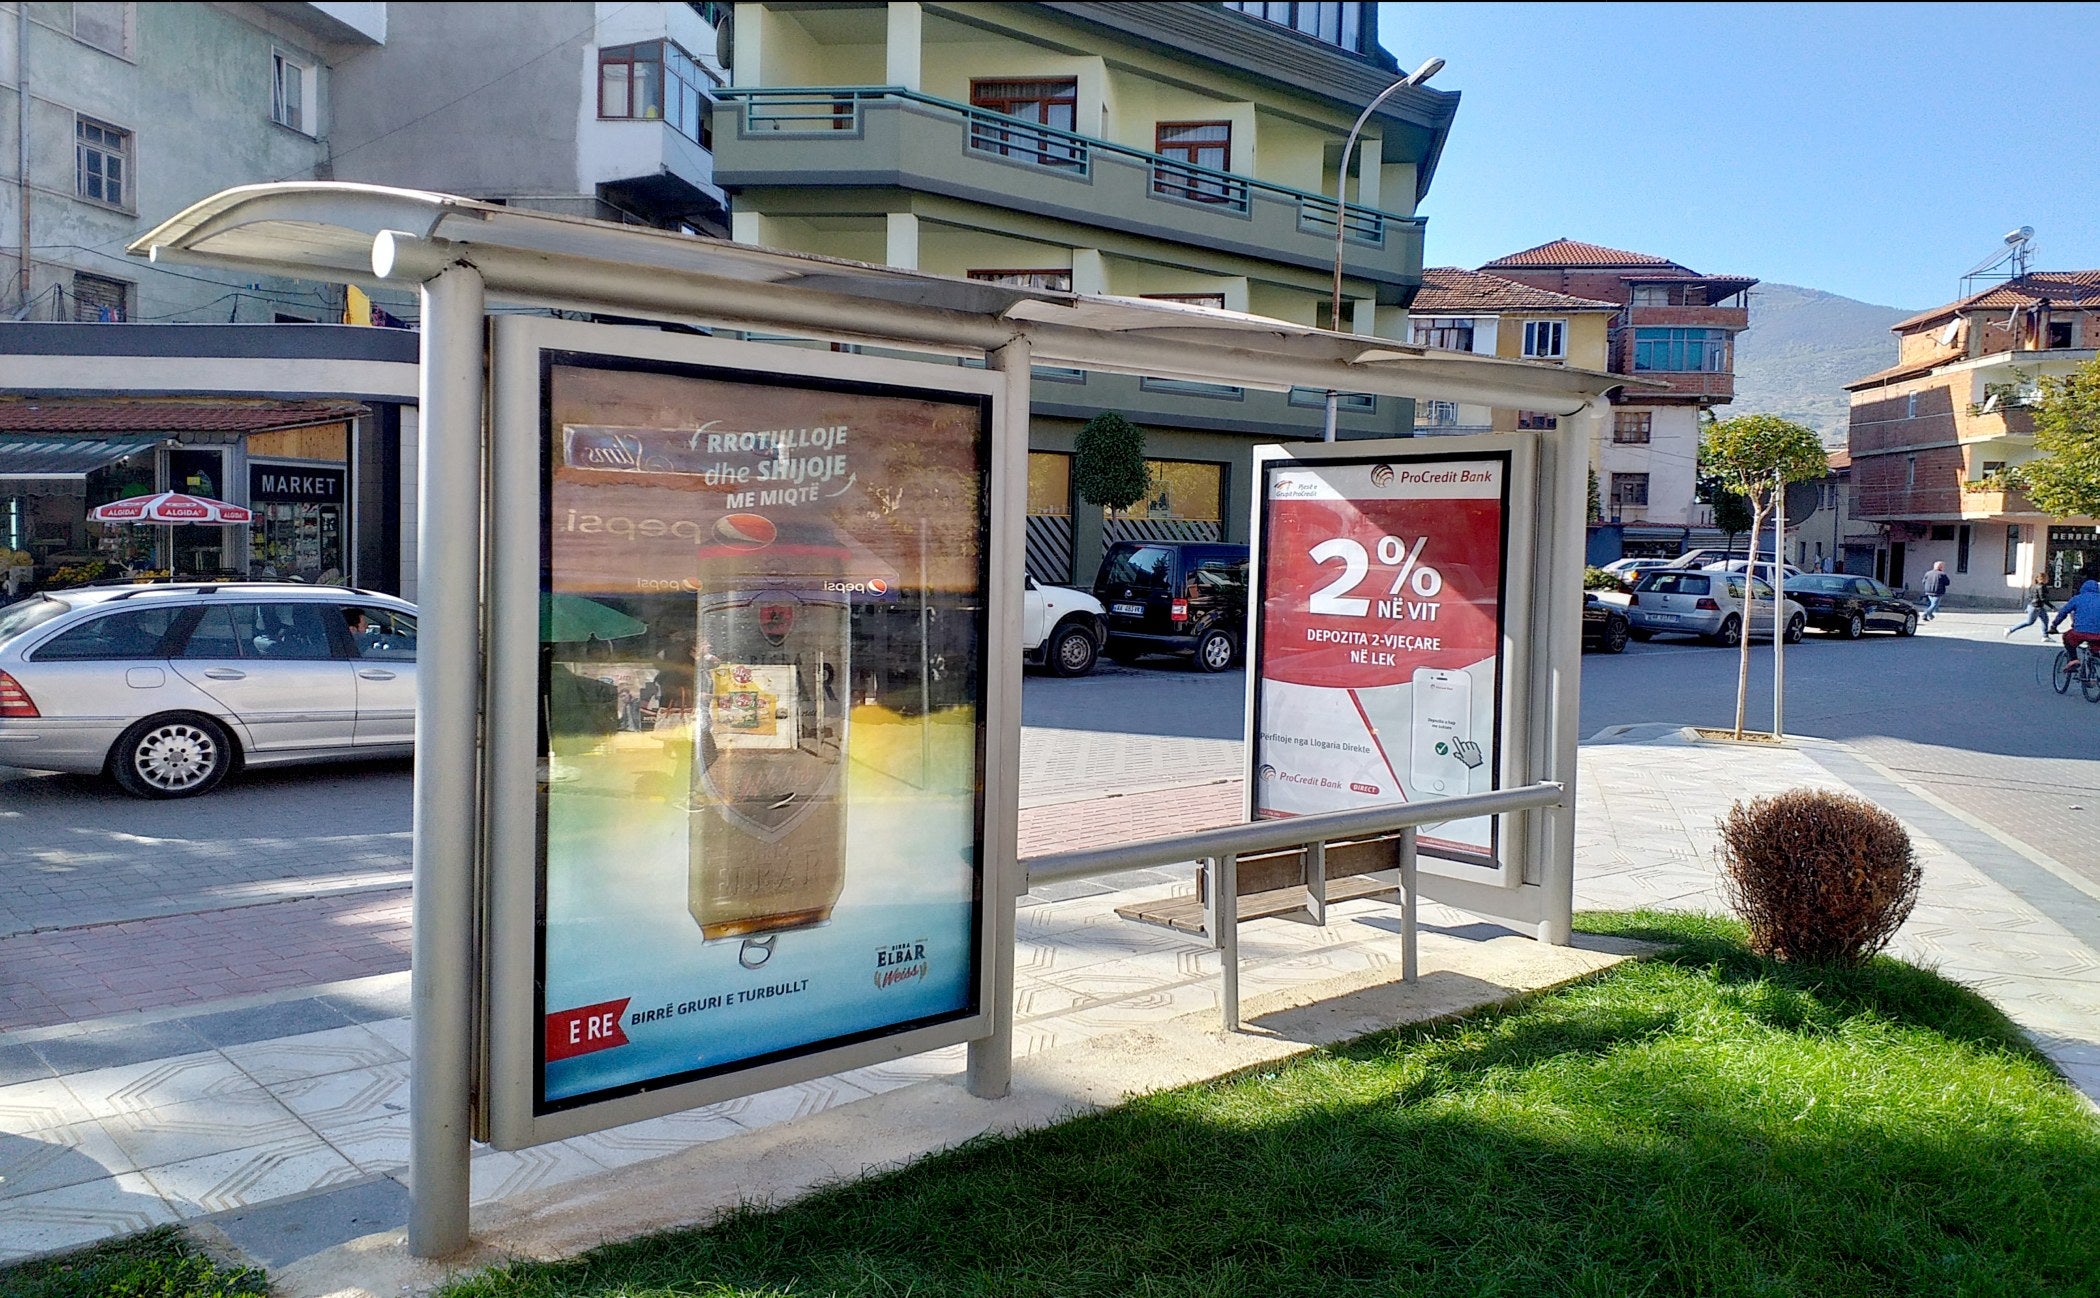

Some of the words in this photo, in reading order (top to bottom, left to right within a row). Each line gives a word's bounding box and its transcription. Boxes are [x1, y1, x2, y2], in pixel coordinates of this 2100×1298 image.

[707, 426, 848, 453] RROTULLOJE
[704, 462, 750, 486] dhe
[757, 455, 847, 485] SHIJOJE
[1401, 470, 1457, 483] ProCredit
[1460, 470, 1492, 482] Bank
[262, 475, 336, 495] MARKET
[726, 492, 755, 509] ME
[760, 482, 819, 507] MIQTË
[108, 509, 135, 517] ALGIDA
[165, 509, 200, 517] ALGIDA
[1309, 534, 1442, 617] 2%
[2053, 550, 2064, 588] MARKO
[1378, 597, 1404, 619] NË
[1407, 601, 1441, 621] VIT
[1307, 628, 1368, 645] DEPOZITA
[1371, 633, 1441, 651] 2-VJEÇARE
[1350, 648, 1368, 664] NË
[1371, 652, 1396, 667] LEK
[1294, 738, 1308, 747] nga
[1310, 738, 1340, 749] Llogaria
[1342, 743, 1371, 754] Direkte
[1279, 771, 1319, 786] ProCredit
[1320, 777, 1342, 790] Bank
[1352, 784, 1376, 793] DIRECT
[877, 944, 925, 968] ELBAR
[882, 964, 920, 989] Weiss
[631, 1003, 673, 1026] BIRRË
[678, 995, 722, 1016] GRURI
[726, 993, 734, 1006] E
[737, 979, 809, 1003] TURBULLT
[569, 1019, 581, 1044] E
[587, 1012, 614, 1040] RE
